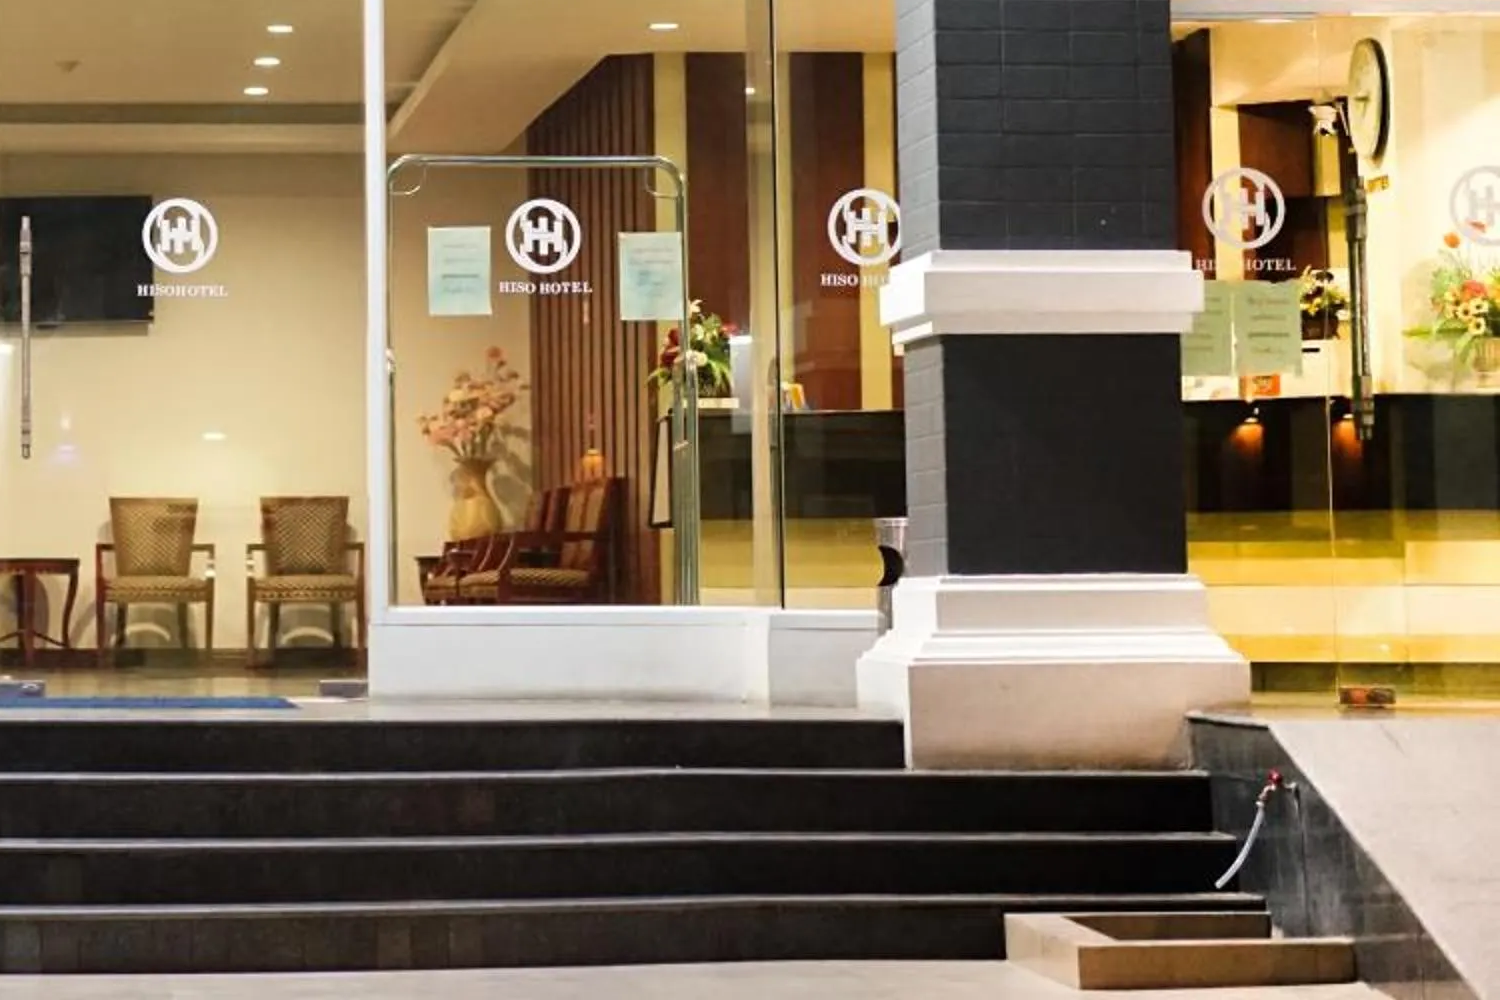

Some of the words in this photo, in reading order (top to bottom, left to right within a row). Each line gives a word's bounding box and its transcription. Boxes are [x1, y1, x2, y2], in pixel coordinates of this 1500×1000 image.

[820, 273, 858, 287] HISO
[499, 280, 537, 294] HISO
[539, 281, 593, 295] HOTEL
